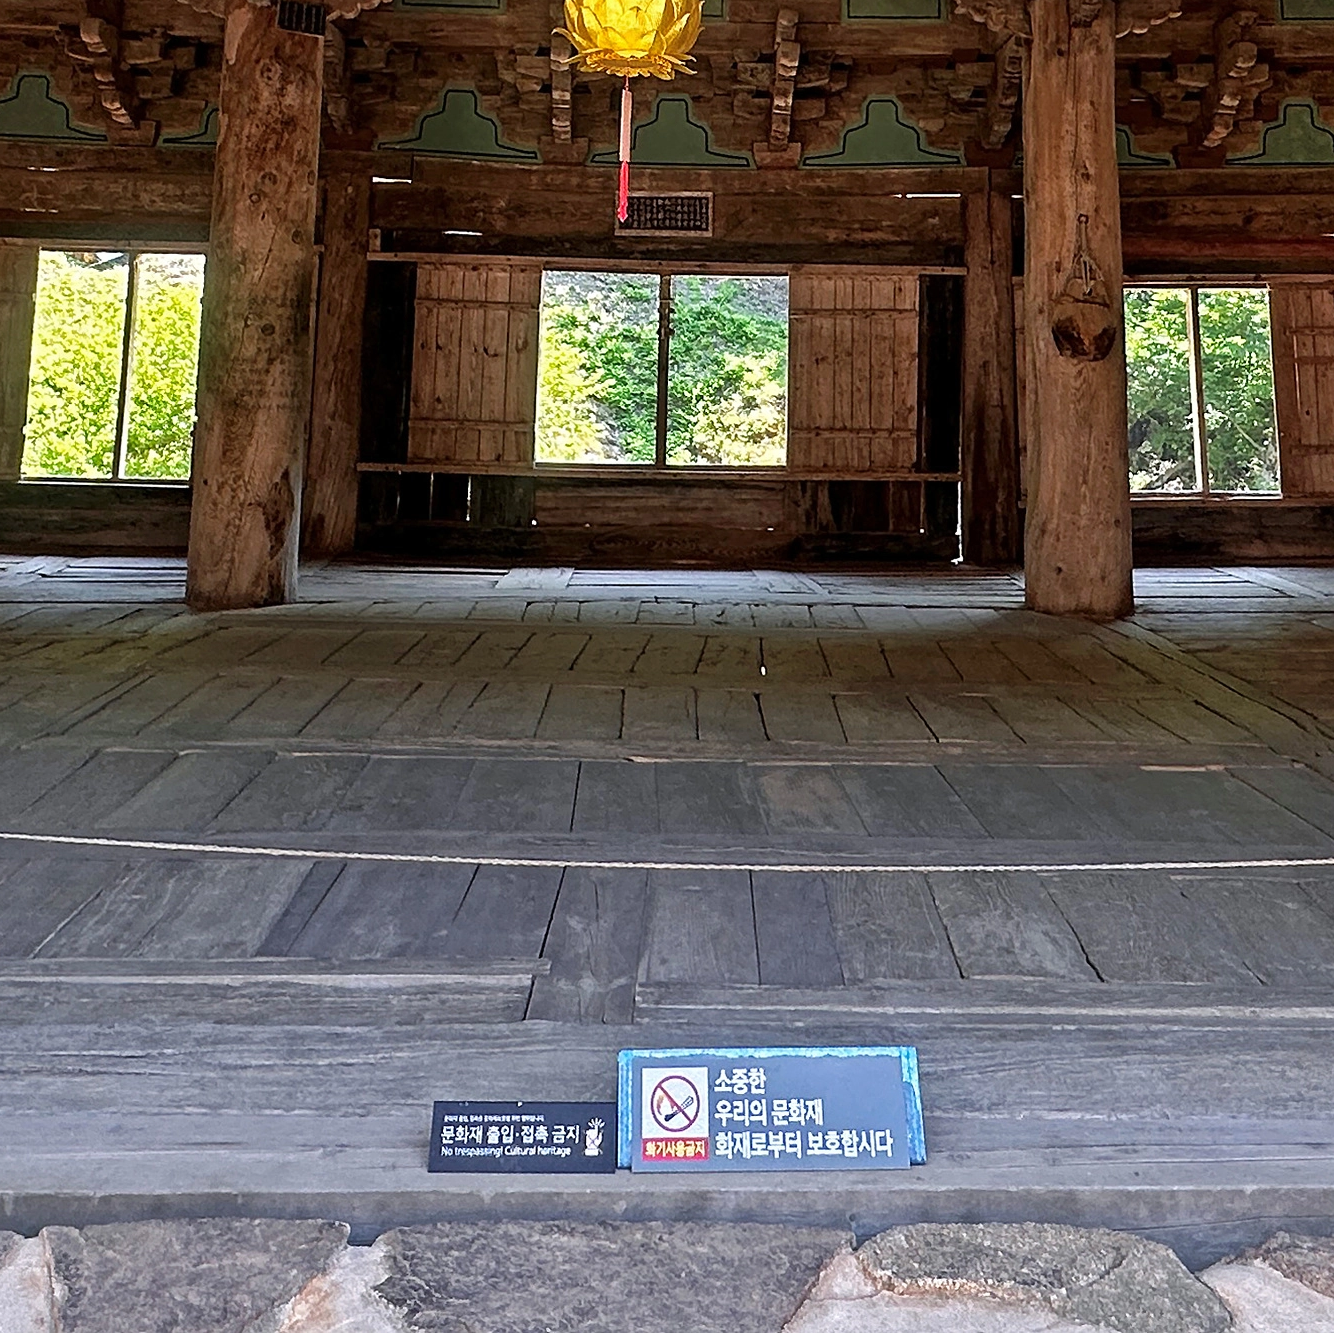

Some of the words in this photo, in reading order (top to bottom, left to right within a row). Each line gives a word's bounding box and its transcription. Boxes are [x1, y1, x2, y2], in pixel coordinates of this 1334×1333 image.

[713, 1068, 766, 1094] 소중한
[713, 1099, 767, 1126] 우리의
[771, 1098, 824, 1126] 문화재
[441, 1125, 483, 1144] 문화재
[551, 1125, 580, 1144] 금지
[714, 1130, 802, 1159] 화재로부터
[807, 1129, 893, 1158] 보호합시다
[441, 1146, 453, 1156] No
[504, 1145, 537, 1156] Cultural
[537, 1145, 572, 1158] heritage
[645, 1140, 706, 1158] 화기사용금지
